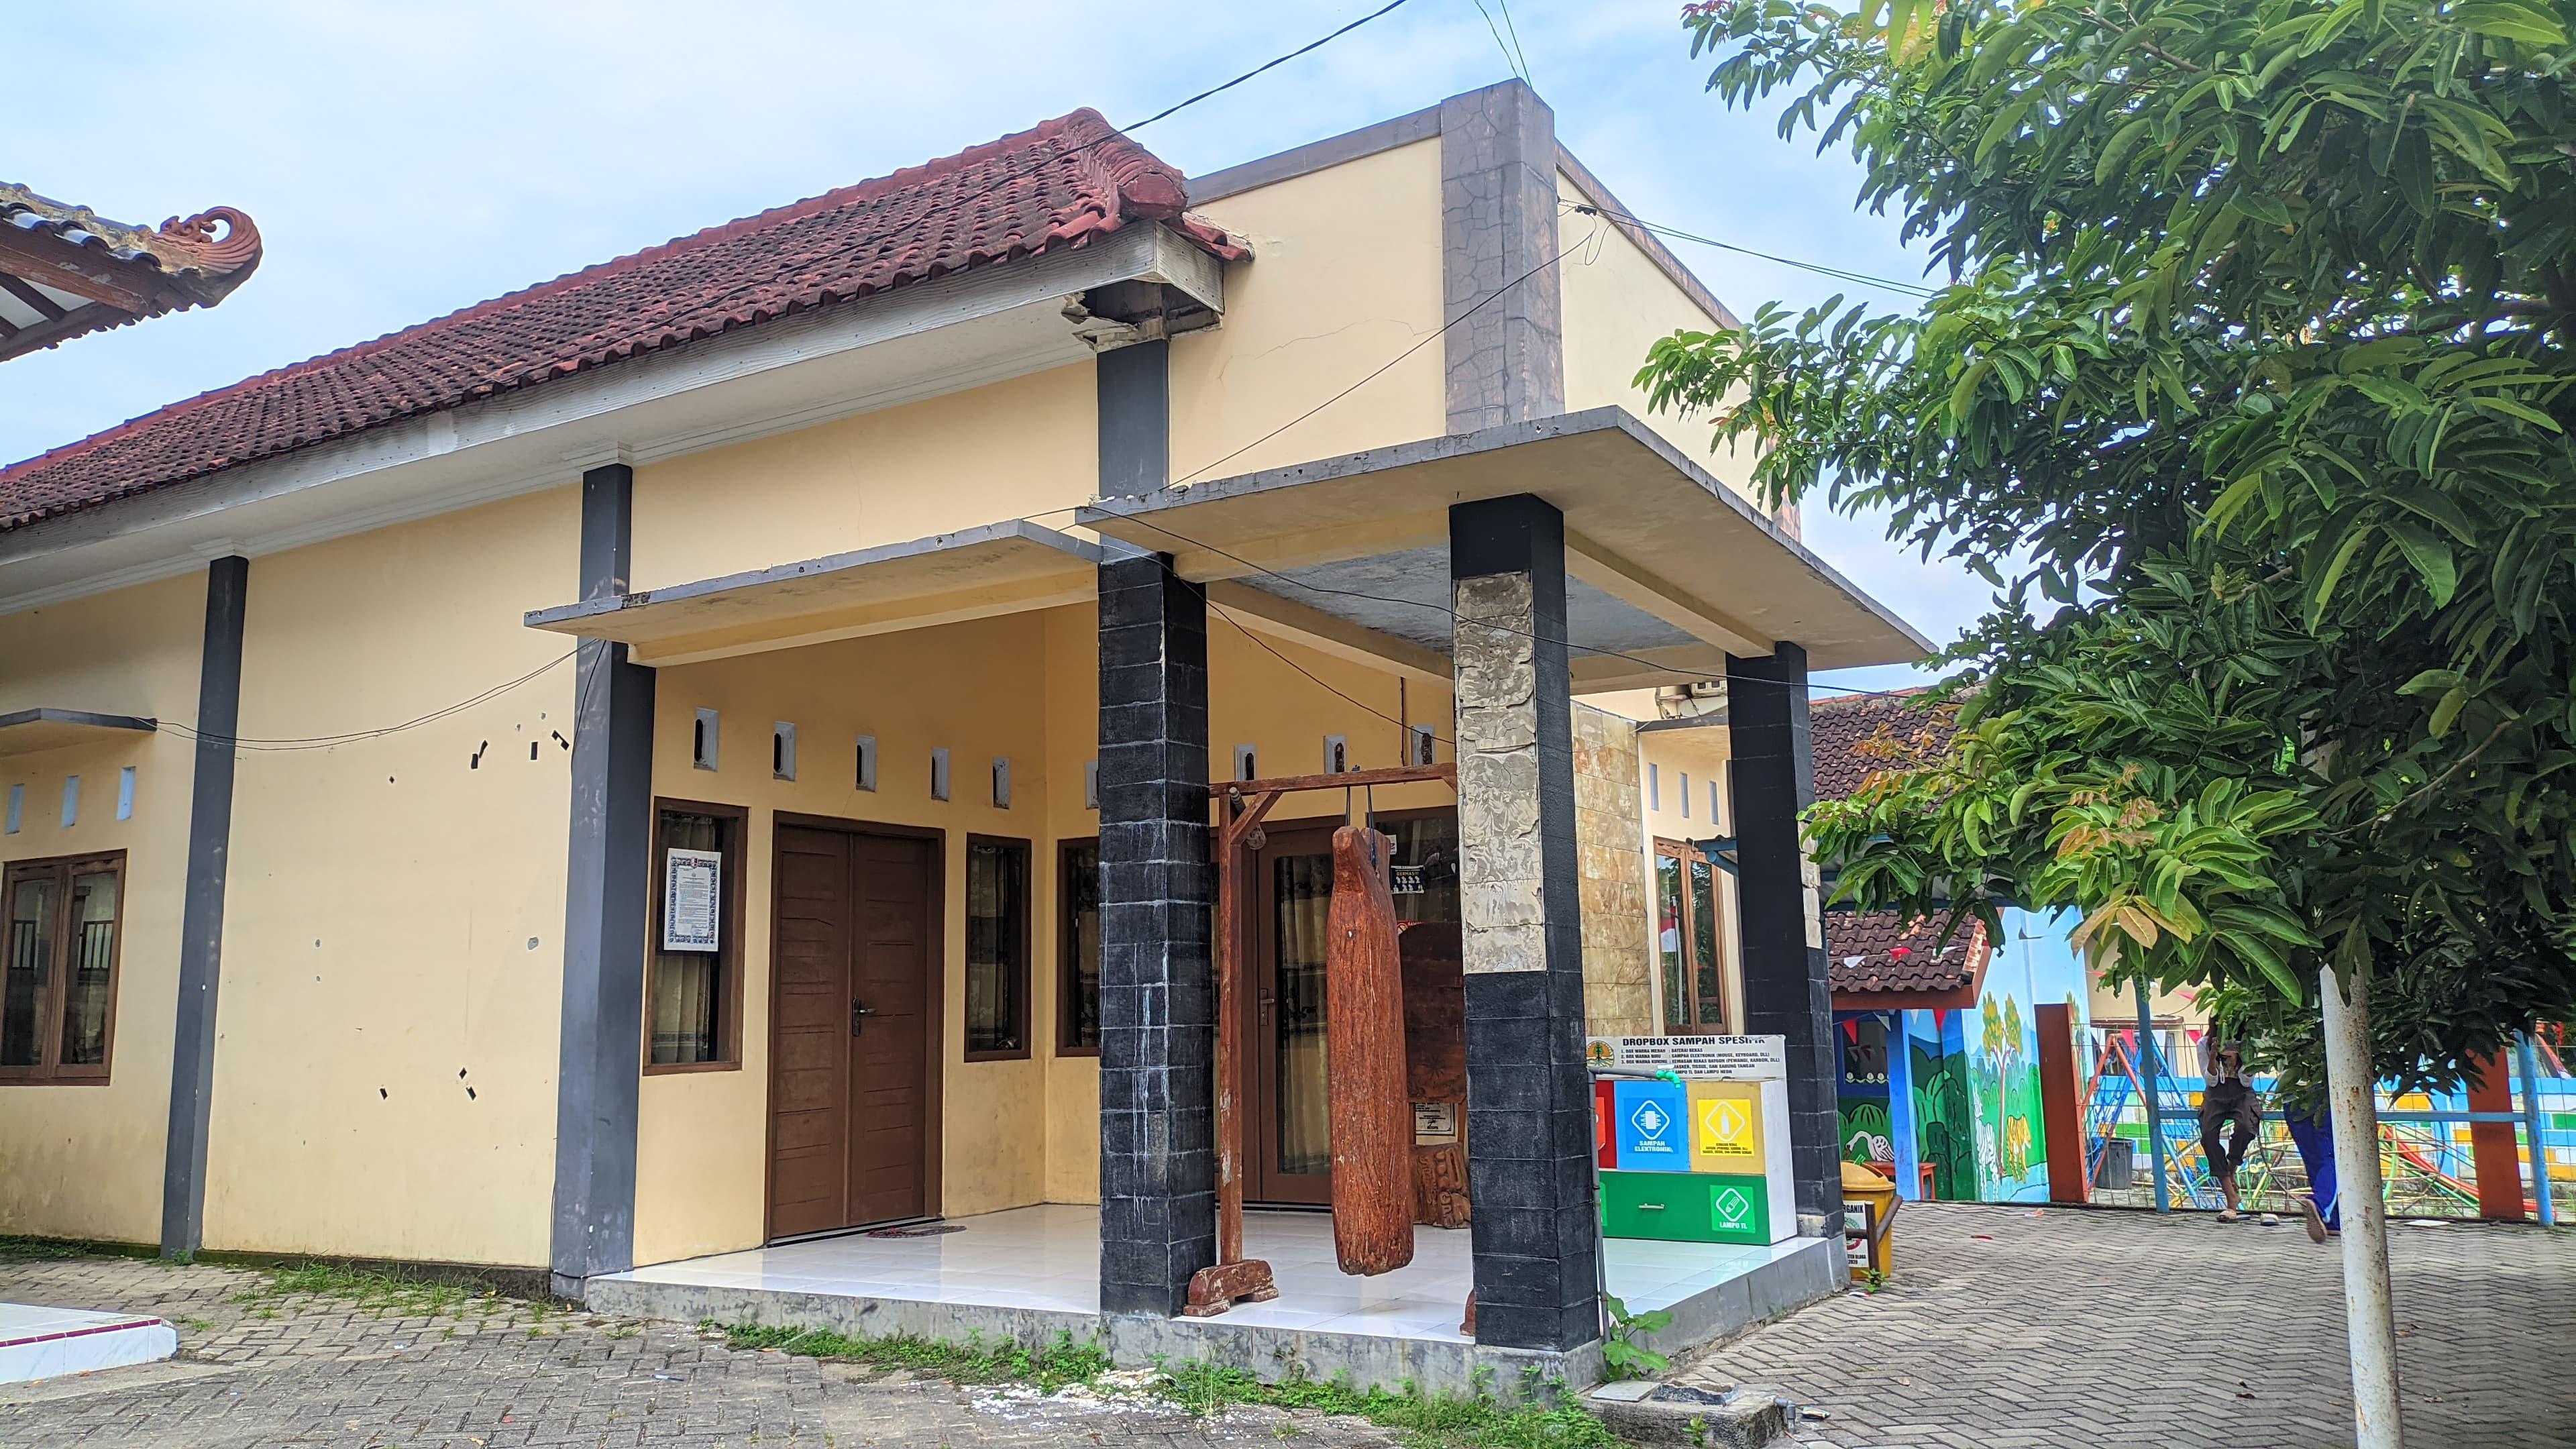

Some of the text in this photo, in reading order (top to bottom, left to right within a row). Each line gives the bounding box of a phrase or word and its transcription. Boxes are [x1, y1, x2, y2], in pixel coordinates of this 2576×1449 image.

[1623, 1038, 1669, 1046] DROPBOX
[1672, 1036, 1715, 1045] SAMPAH
[1842, 1204, 1864, 1213] RGANIK
